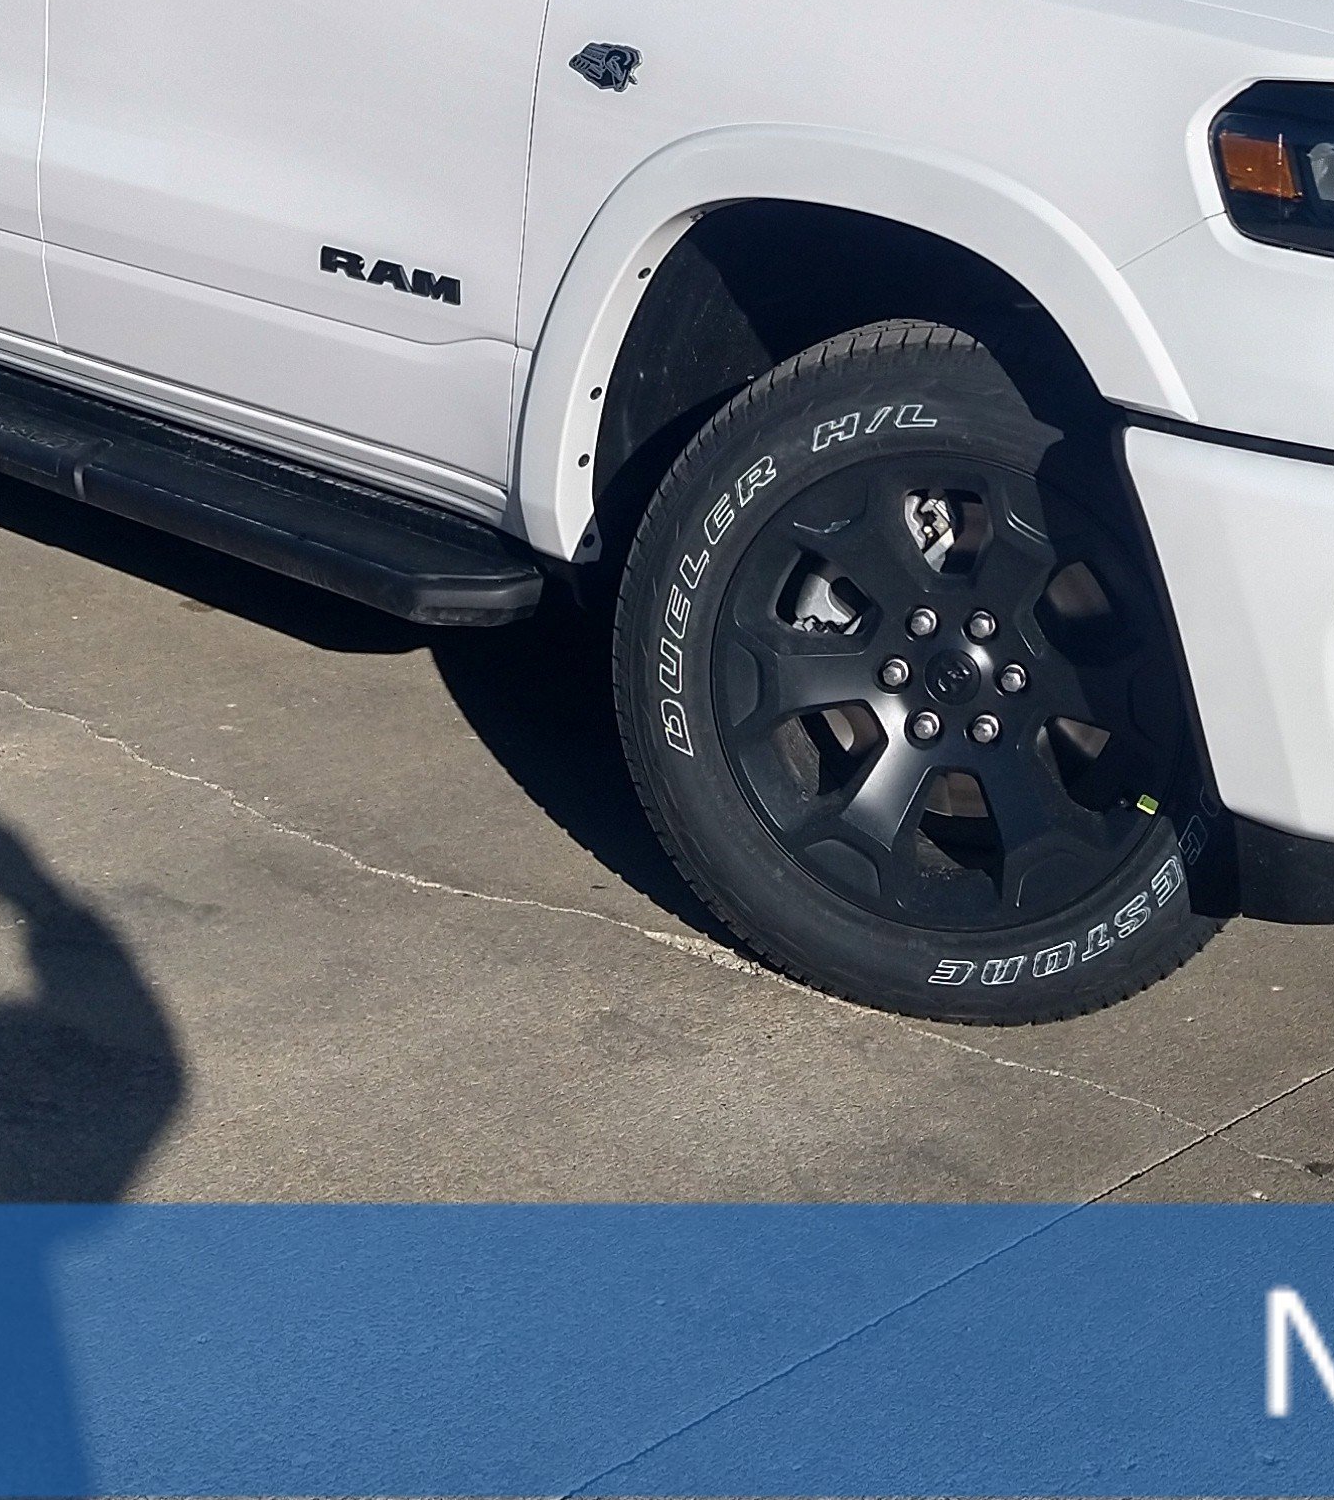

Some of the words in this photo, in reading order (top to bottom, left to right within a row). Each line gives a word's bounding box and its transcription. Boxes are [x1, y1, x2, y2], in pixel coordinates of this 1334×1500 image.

[320, 245, 462, 306] RAM
[661, 453, 777, 757] DUELER
[811, 403, 939, 452] H/L
